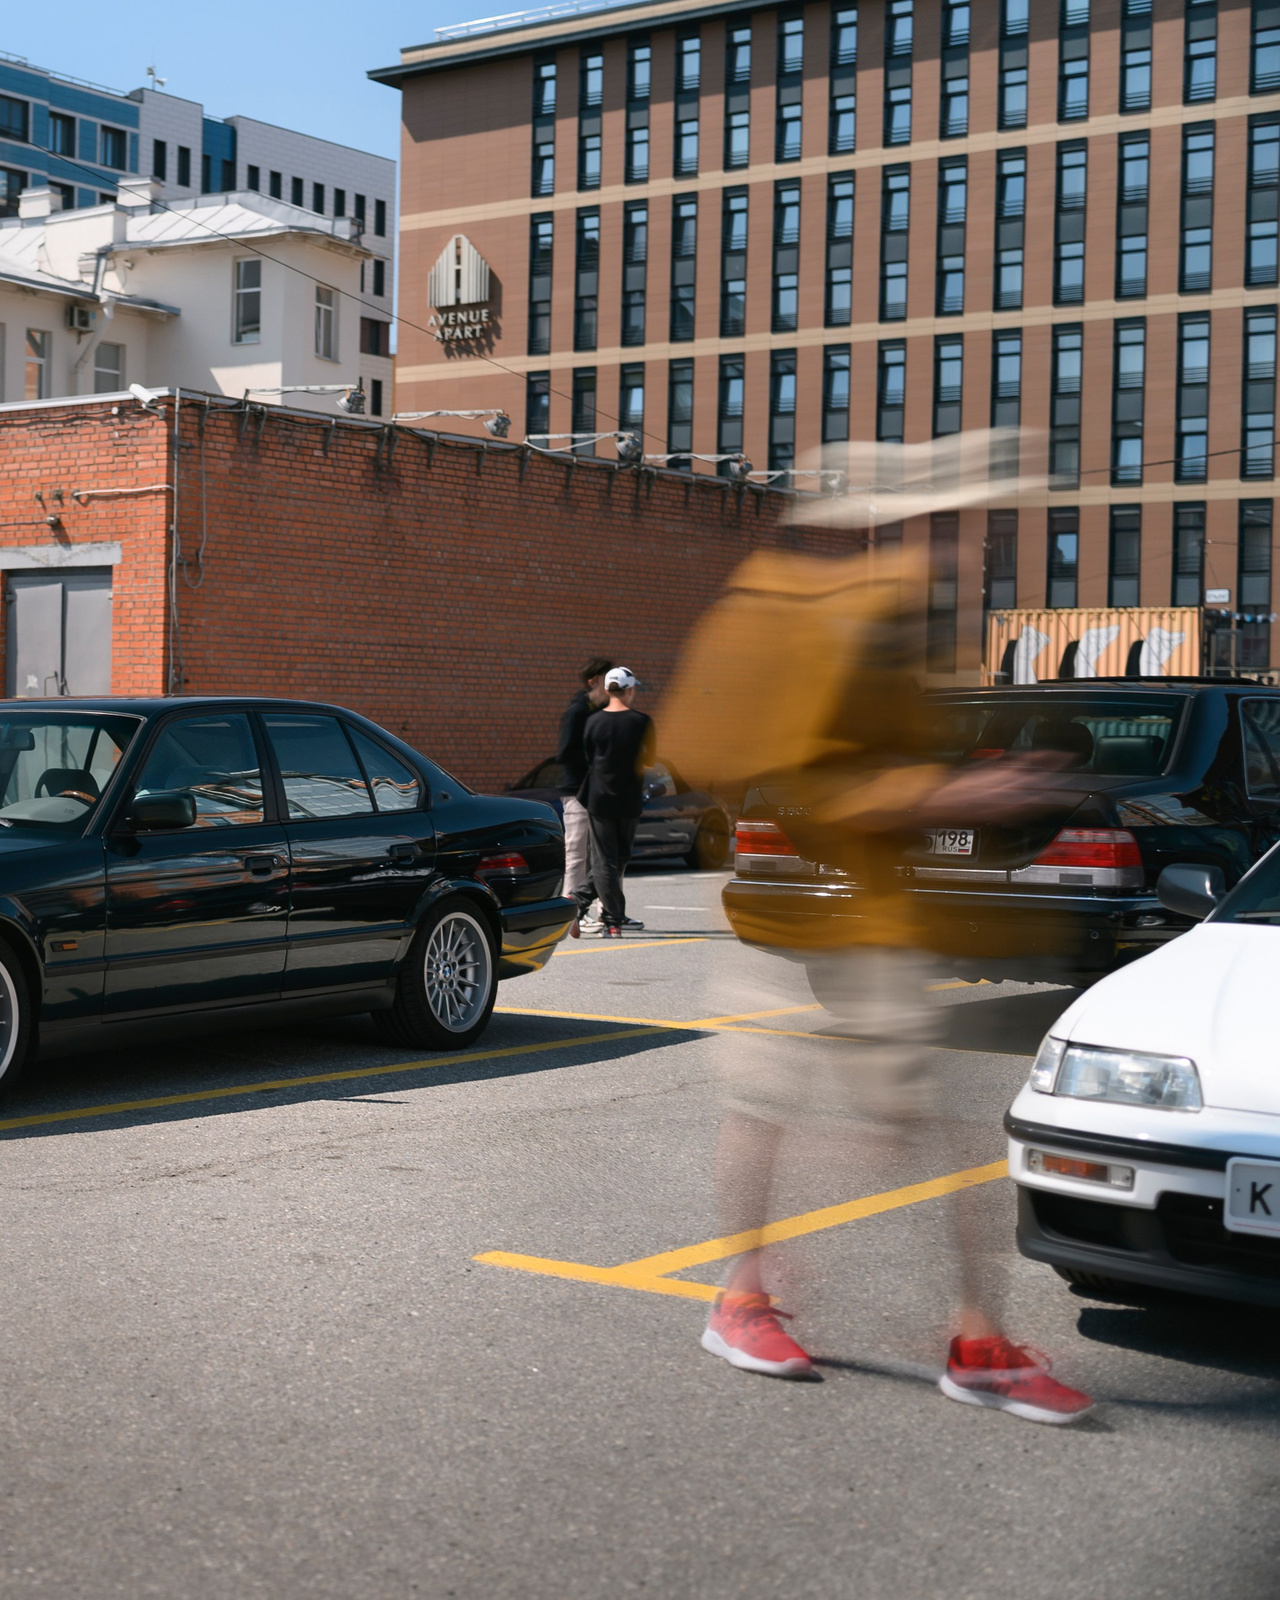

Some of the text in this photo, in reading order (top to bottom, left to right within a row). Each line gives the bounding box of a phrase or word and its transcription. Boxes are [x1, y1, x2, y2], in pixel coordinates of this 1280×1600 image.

[428, 309, 489, 327] AVENUE
[433, 324, 482, 342] APART
[938, 831, 968, 847] 198
